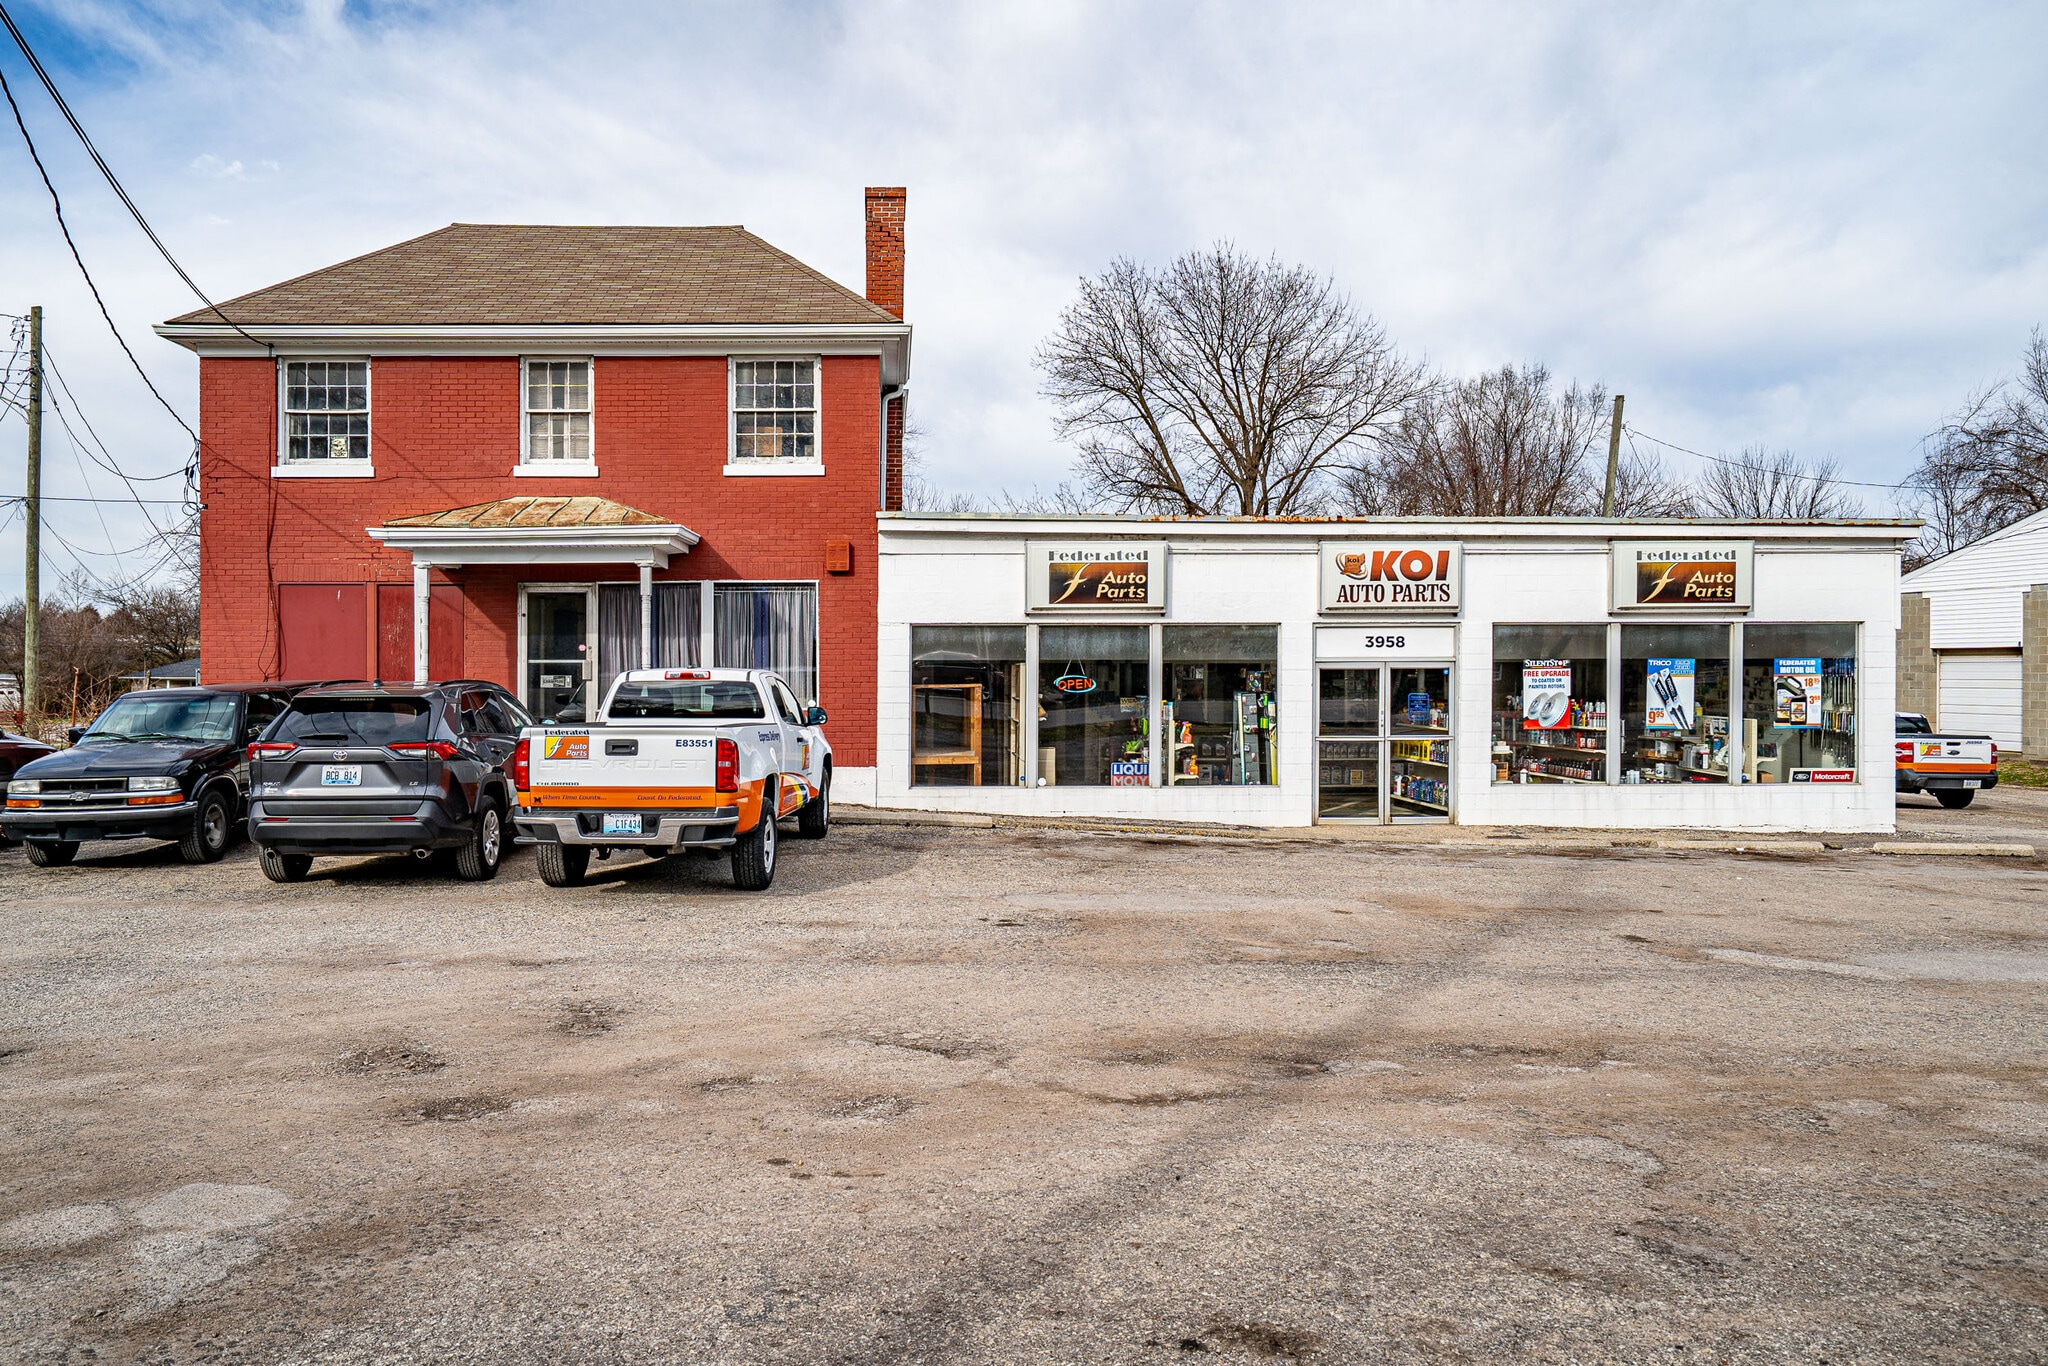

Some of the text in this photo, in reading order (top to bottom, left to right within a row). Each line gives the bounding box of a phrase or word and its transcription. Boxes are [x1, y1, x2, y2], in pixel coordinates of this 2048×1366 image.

[1048, 550, 1148, 561] Federated
[1636, 549, 1736, 560] Federated
[1369, 550, 1450, 581] KOI
[1101, 570, 1147, 584] Auto
[1689, 570, 1734, 583] Auto
[1095, 584, 1146, 598] Parts
[1336, 583, 1451, 603] AUTO PARTS
[1683, 583, 1733, 598] Parts
[1365, 636, 1405, 648] 3958
[1057, 678, 1093, 691] OPEN
[538, 759, 707, 770] CHEVROLET
[1113, 764, 1148, 775] LIQUI
[344, 771, 357, 781] 814
[1113, 776, 1148, 786] MOLY
[615, 820, 641, 829] C1F434
